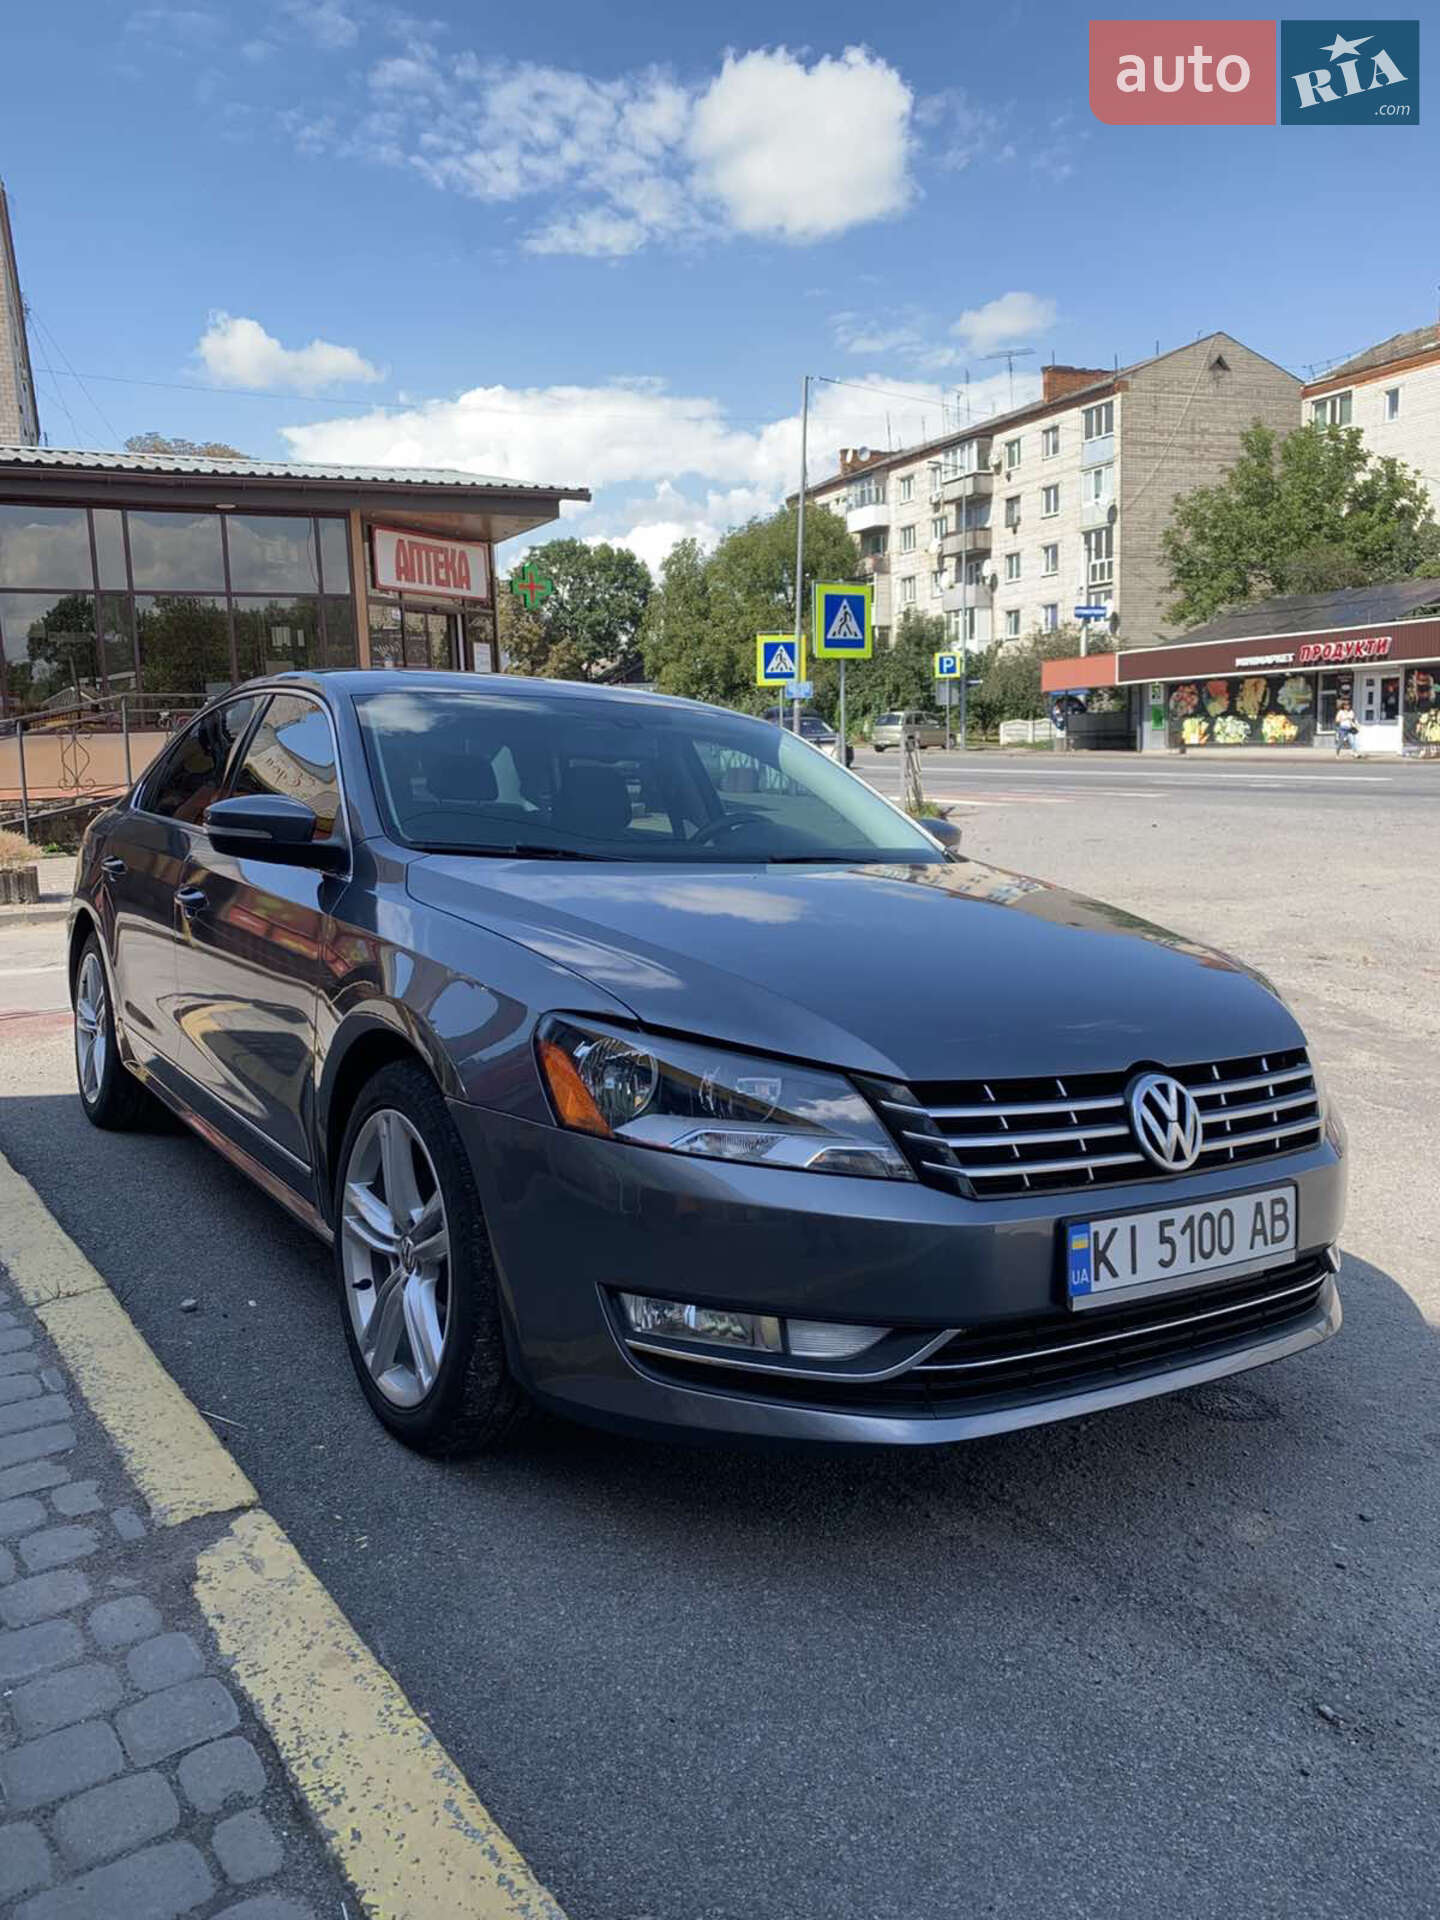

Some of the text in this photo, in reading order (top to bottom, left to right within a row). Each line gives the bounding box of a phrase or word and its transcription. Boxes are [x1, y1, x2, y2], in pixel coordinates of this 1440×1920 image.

[395, 538, 471, 591] АПТЕКА
[1299, 637, 1392, 661] ПРОДУКТИ
[1158, 1208, 1235, 1268] 5100
[1250, 1196, 1290, 1250] AB
[1072, 1267, 1090, 1285] UA
